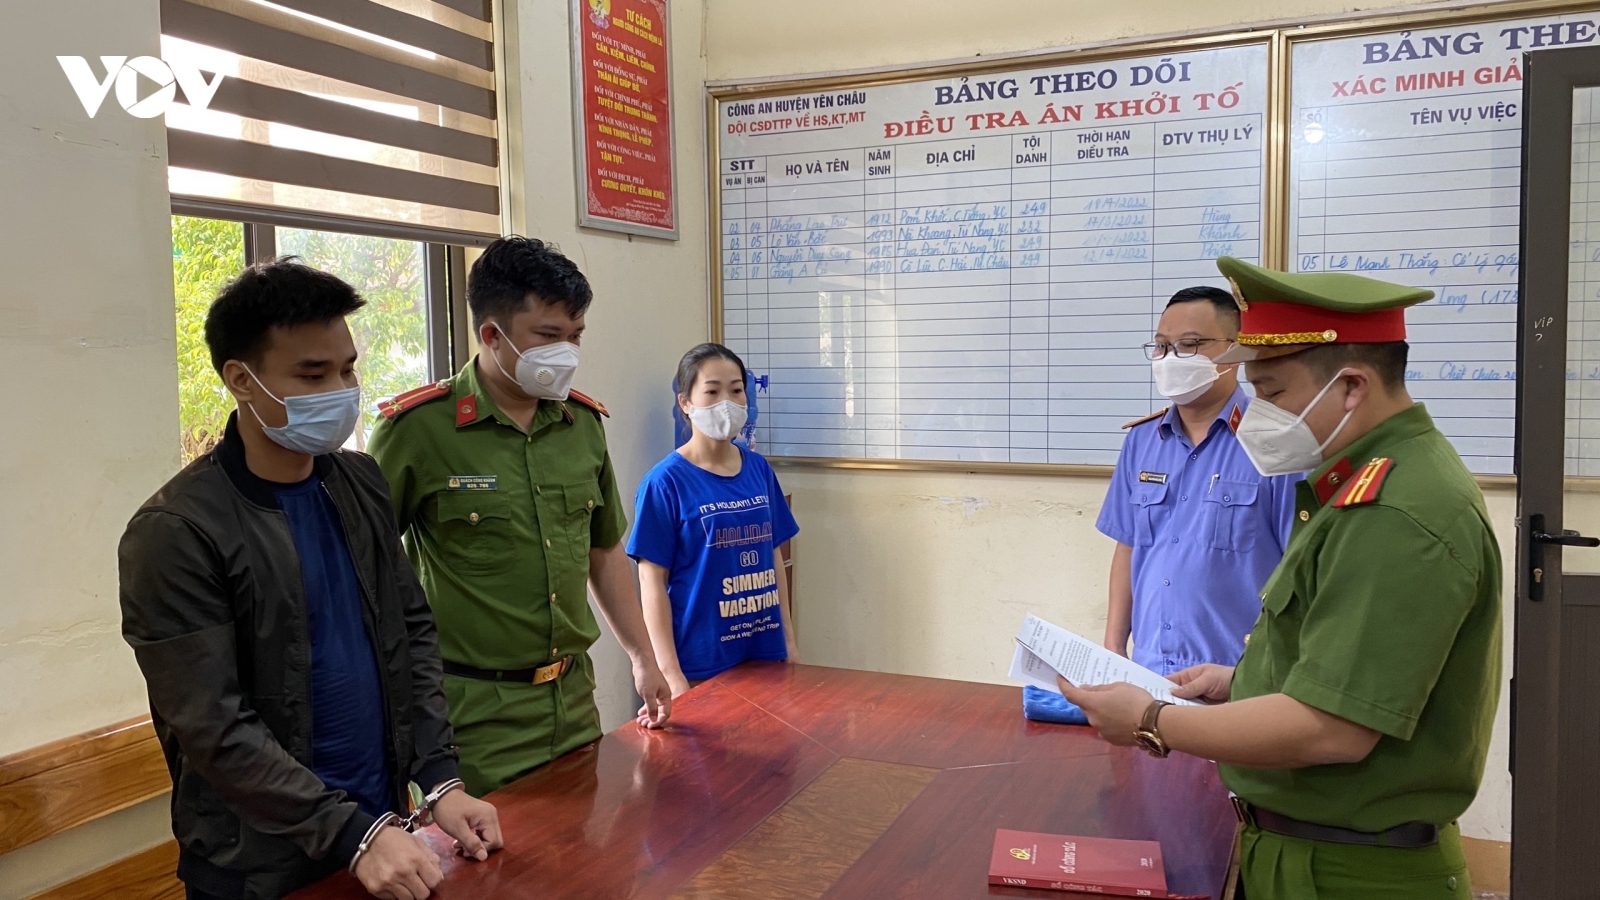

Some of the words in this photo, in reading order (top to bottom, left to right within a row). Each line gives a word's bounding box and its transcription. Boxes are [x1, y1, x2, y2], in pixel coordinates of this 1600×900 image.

[1362, 31, 1483, 64] BẢNG
[1500, 20, 1600, 50] THE
[935, 76, 1018, 105] BẢNG
[1030, 69, 1117, 95] THEO
[1130, 58, 1191, 86] DÕI
[1332, 75, 1386, 97] XÁC
[1395, 70, 1464, 92] MINH
[727, 102, 755, 117] CÔNG
[758, 102, 772, 114] AN
[775, 97, 810, 115] HUYỆN
[813, 93, 833, 109] YÊN
[837, 91, 866, 106] CHÂU
[884, 110, 955, 138] ĐIỀU
[965, 110, 1029, 130] TRA
[1038, 103, 1083, 124] ÁN
[1095, 91, 1181, 119] KHỞI
[1193, 81, 1243, 111] TỐ
[1410, 108, 1442, 125] TÊN
[1448, 107, 1472, 125] VỤ
[1478, 101, 1517, 122] VIỆC
[727, 122, 747, 137] ĐỘI
[749, 117, 792, 132] CSĐTTP
[796, 112, 810, 128] VỀ
[813, 111, 866, 126] HS,KT,MT
[1023, 135, 1040, 150] TỘI
[1077, 130, 1103, 144] THỜI
[1106, 130, 1130, 144] HẠN
[1162, 133, 1193, 146] ĐTV
[1198, 128, 1229, 145] THỤ
[1234, 124, 1253, 140] LÝ
[868, 149, 891, 162] NĂM
[926, 152, 949, 167] ĐỊA
[953, 145, 975, 162] CHỈ
[1016, 153, 1047, 164] DANH
[1077, 145, 1103, 160] ĐIỀU
[1107, 146, 1129, 157] TRA
[730, 159, 755, 171] STT
[786, 164, 802, 178] HỌ
[806, 159, 822, 174] VÀ
[826, 158, 849, 172] TÊN
[868, 165, 891, 176] SINH
[726, 177, 734, 186] VỤ
[734, 176, 742, 185] ÁN
[754, 176, 765, 184] CAN
[751, 235, 764, 247] 05
[867, 229, 893, 240] 1993
[752, 251, 762, 262] 06
[1302, 255, 1319, 270] 05
[1330, 255, 1348, 268] Lê
[867, 261, 891, 273] 1990
[699, 503, 716, 514] IT'S
[740, 550, 759, 567] GO
[722, 568, 776, 596] SUMMER
[719, 589, 780, 618] VACATION
[730, 624, 742, 632] GET
